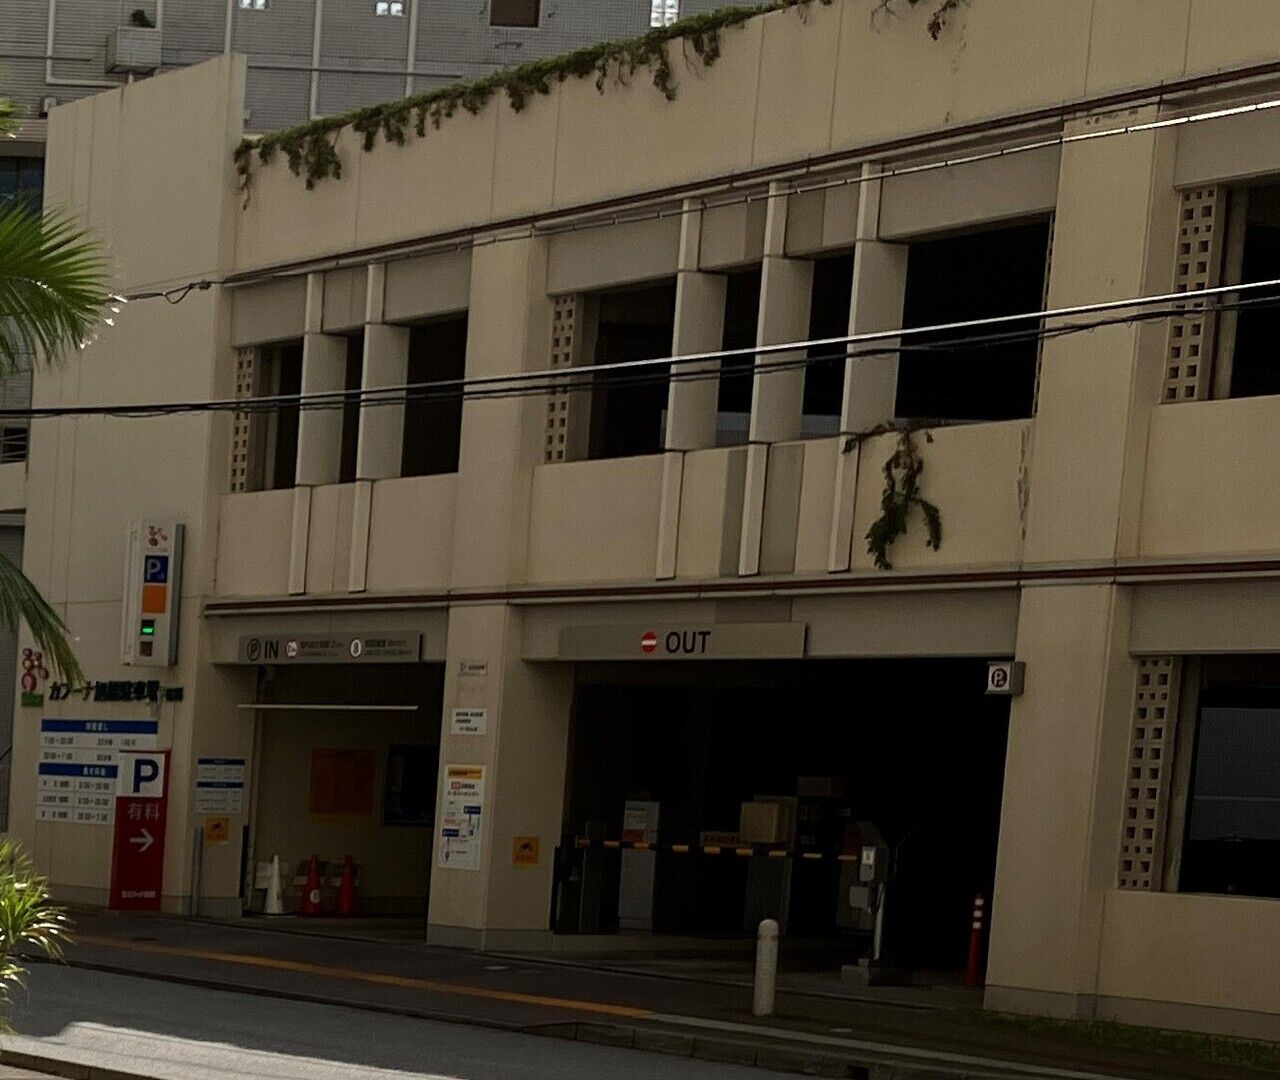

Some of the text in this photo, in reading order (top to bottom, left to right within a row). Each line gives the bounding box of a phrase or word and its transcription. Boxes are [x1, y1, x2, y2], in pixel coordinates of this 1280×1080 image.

[147, 558, 161, 581] P
[264, 640, 279, 659] IN
[665, 631, 711, 653] OUT
[133, 758, 159, 793] P
[127, 802, 160, 821] 有料
